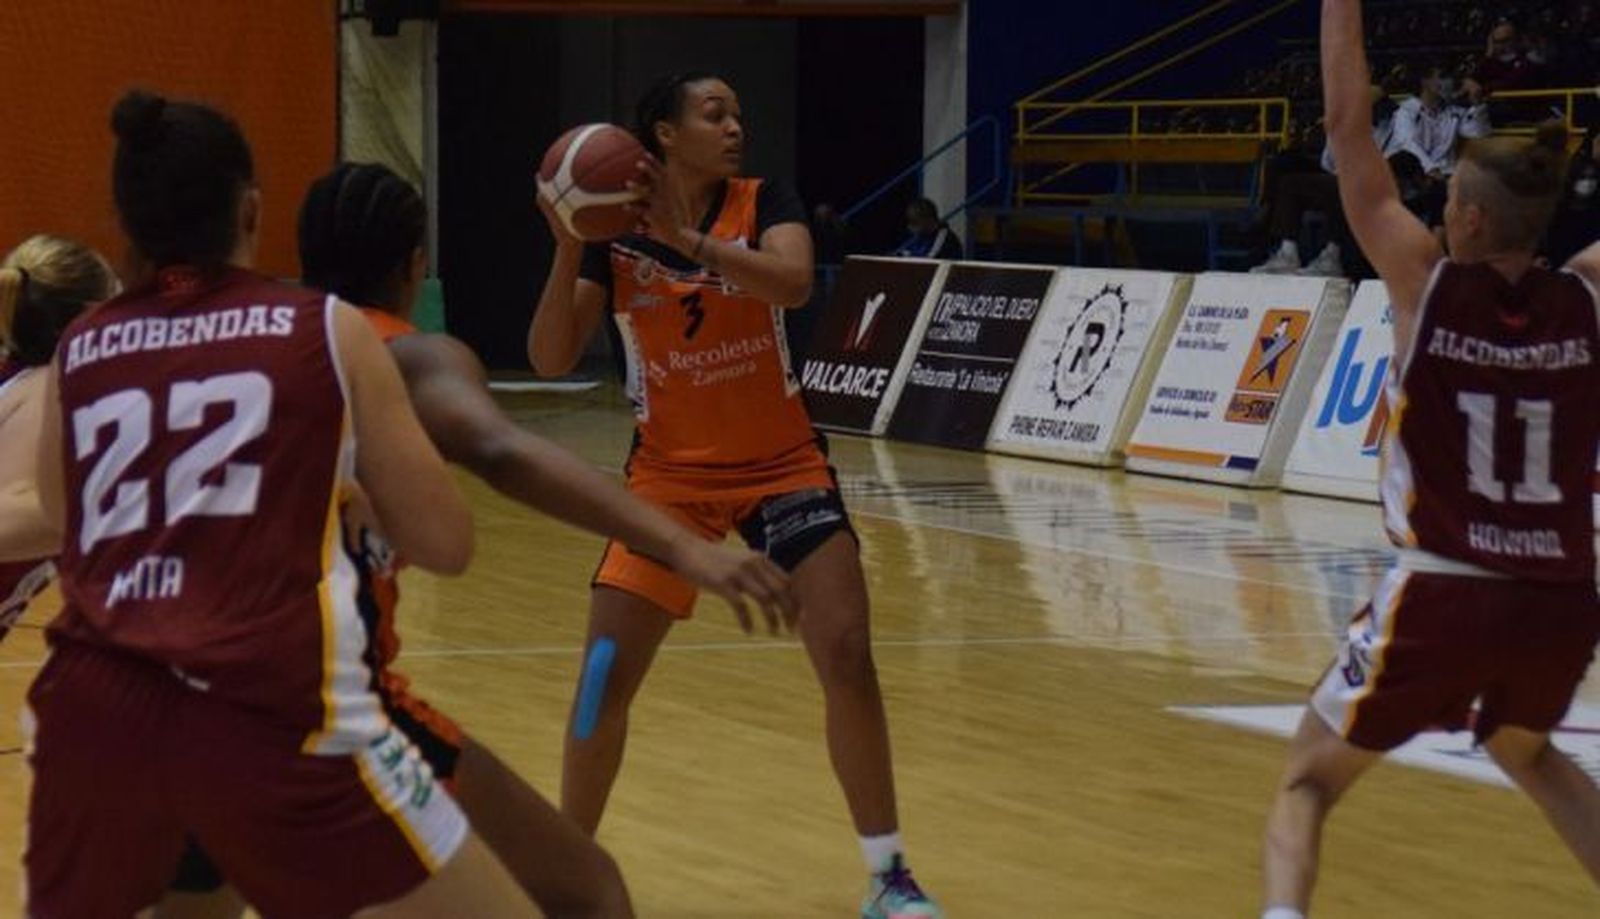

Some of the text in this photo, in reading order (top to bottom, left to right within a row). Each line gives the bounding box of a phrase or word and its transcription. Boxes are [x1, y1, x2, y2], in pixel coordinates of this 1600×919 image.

[680, 293, 705, 340] 3
[65, 306, 296, 373] ALCOBENDAS
[668, 333, 773, 371] Recoletas
[1428, 327, 1592, 371] ALCOBENDAS
[690, 358, 758, 387] Zamora
[802, 359, 889, 399] VALCARCE
[72, 370, 273, 556] 22
[1457, 391, 1562, 503] 11
